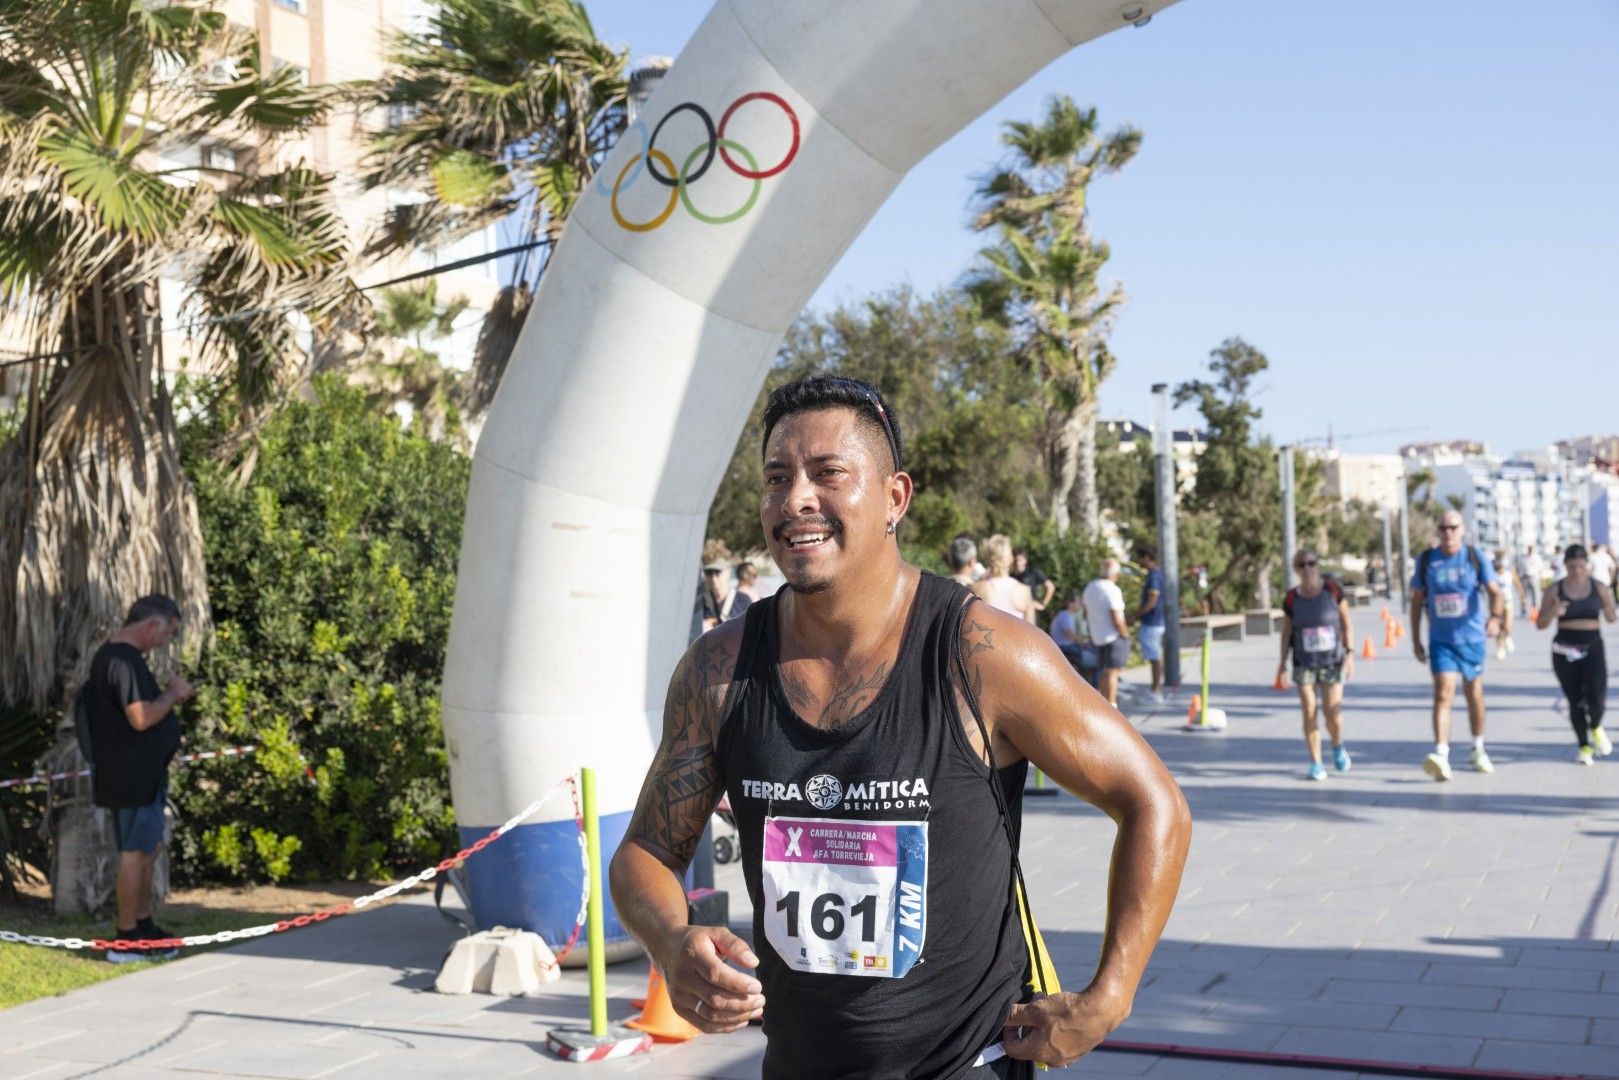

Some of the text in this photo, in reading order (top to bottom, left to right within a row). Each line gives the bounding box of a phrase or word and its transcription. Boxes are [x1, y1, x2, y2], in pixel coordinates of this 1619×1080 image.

[742, 780, 803, 801] TERRA
[844, 801, 930, 811] BENIDORM
[784, 826, 804, 857] X
[810, 828, 877, 841] CARRERA/MARCHA
[826, 840, 861, 850] SOLIDARIA
[813, 850, 874, 862] AFA TORREVIEJA
[776, 890, 879, 942] 161
[899, 880, 922, 953] 7 KM
